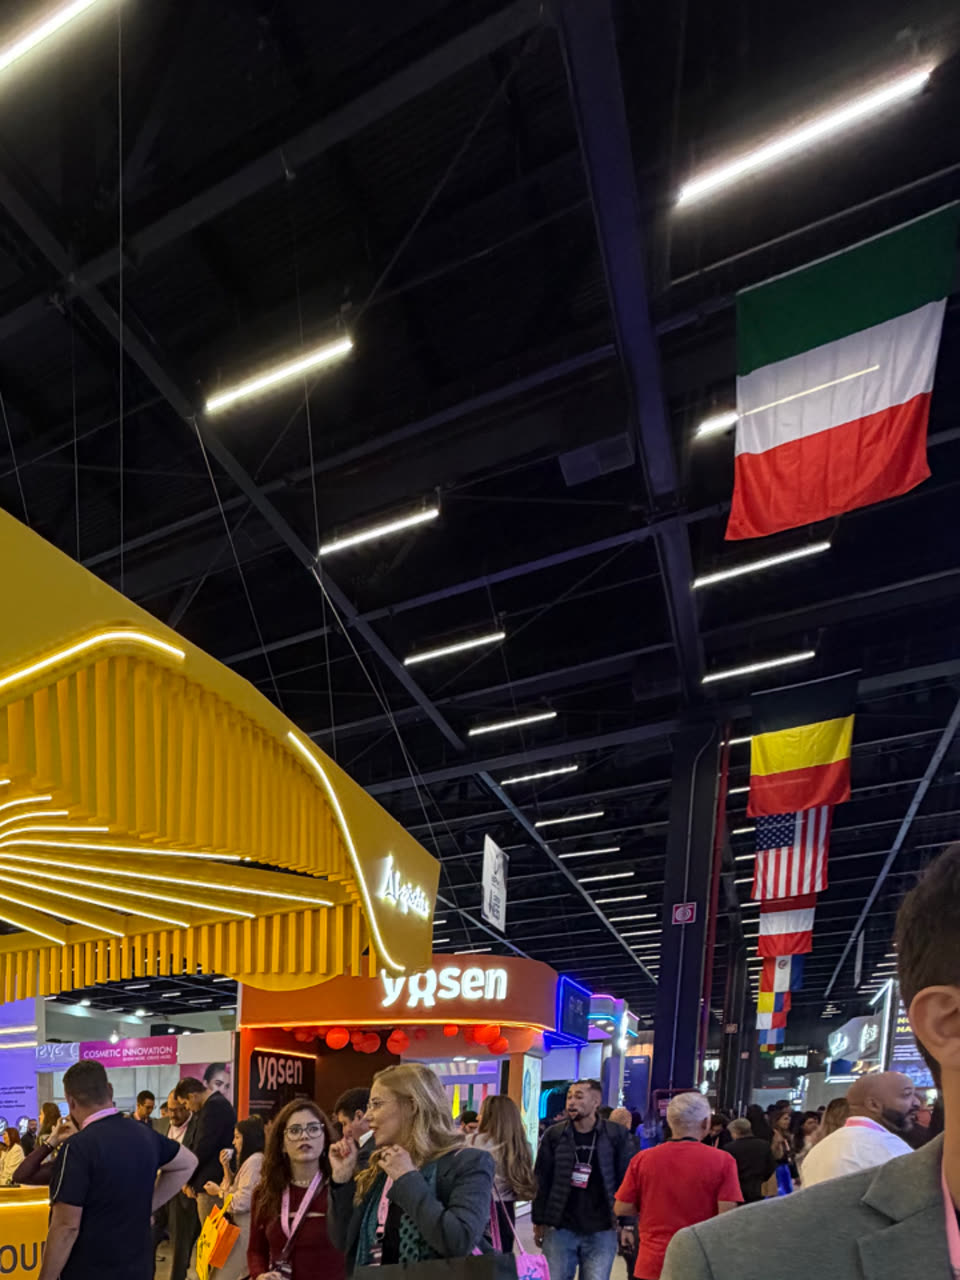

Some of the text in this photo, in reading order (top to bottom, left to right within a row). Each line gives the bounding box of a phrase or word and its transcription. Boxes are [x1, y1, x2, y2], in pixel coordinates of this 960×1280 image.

[83, 1048, 121, 1059] COSMETIC
[122, 1046, 173, 1056] INNOVATION
[257, 1055, 303, 1090] yosen
